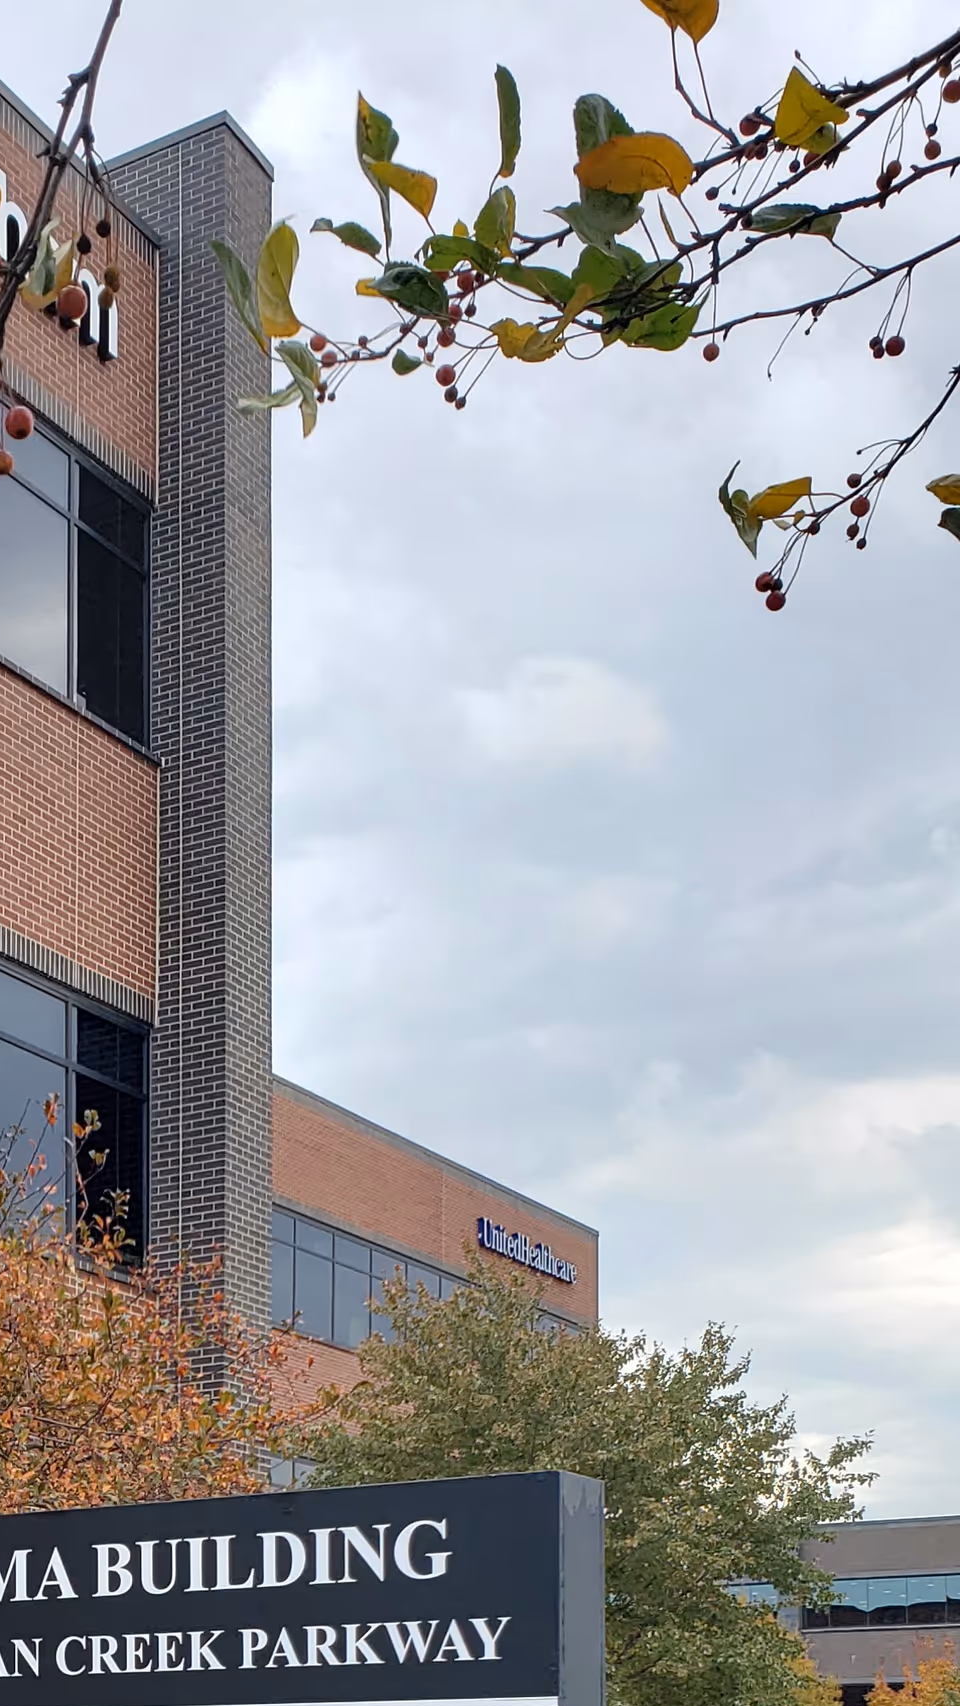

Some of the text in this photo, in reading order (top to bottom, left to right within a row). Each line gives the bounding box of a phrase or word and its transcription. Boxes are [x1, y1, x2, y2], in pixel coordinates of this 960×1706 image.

[483, 1217, 577, 1284] UnitedHealthcare
[91, 1518, 453, 1598] BUILDING
[55, 1629, 227, 1678] CREEK
[237, 1616, 512, 1669] PARKWAY
